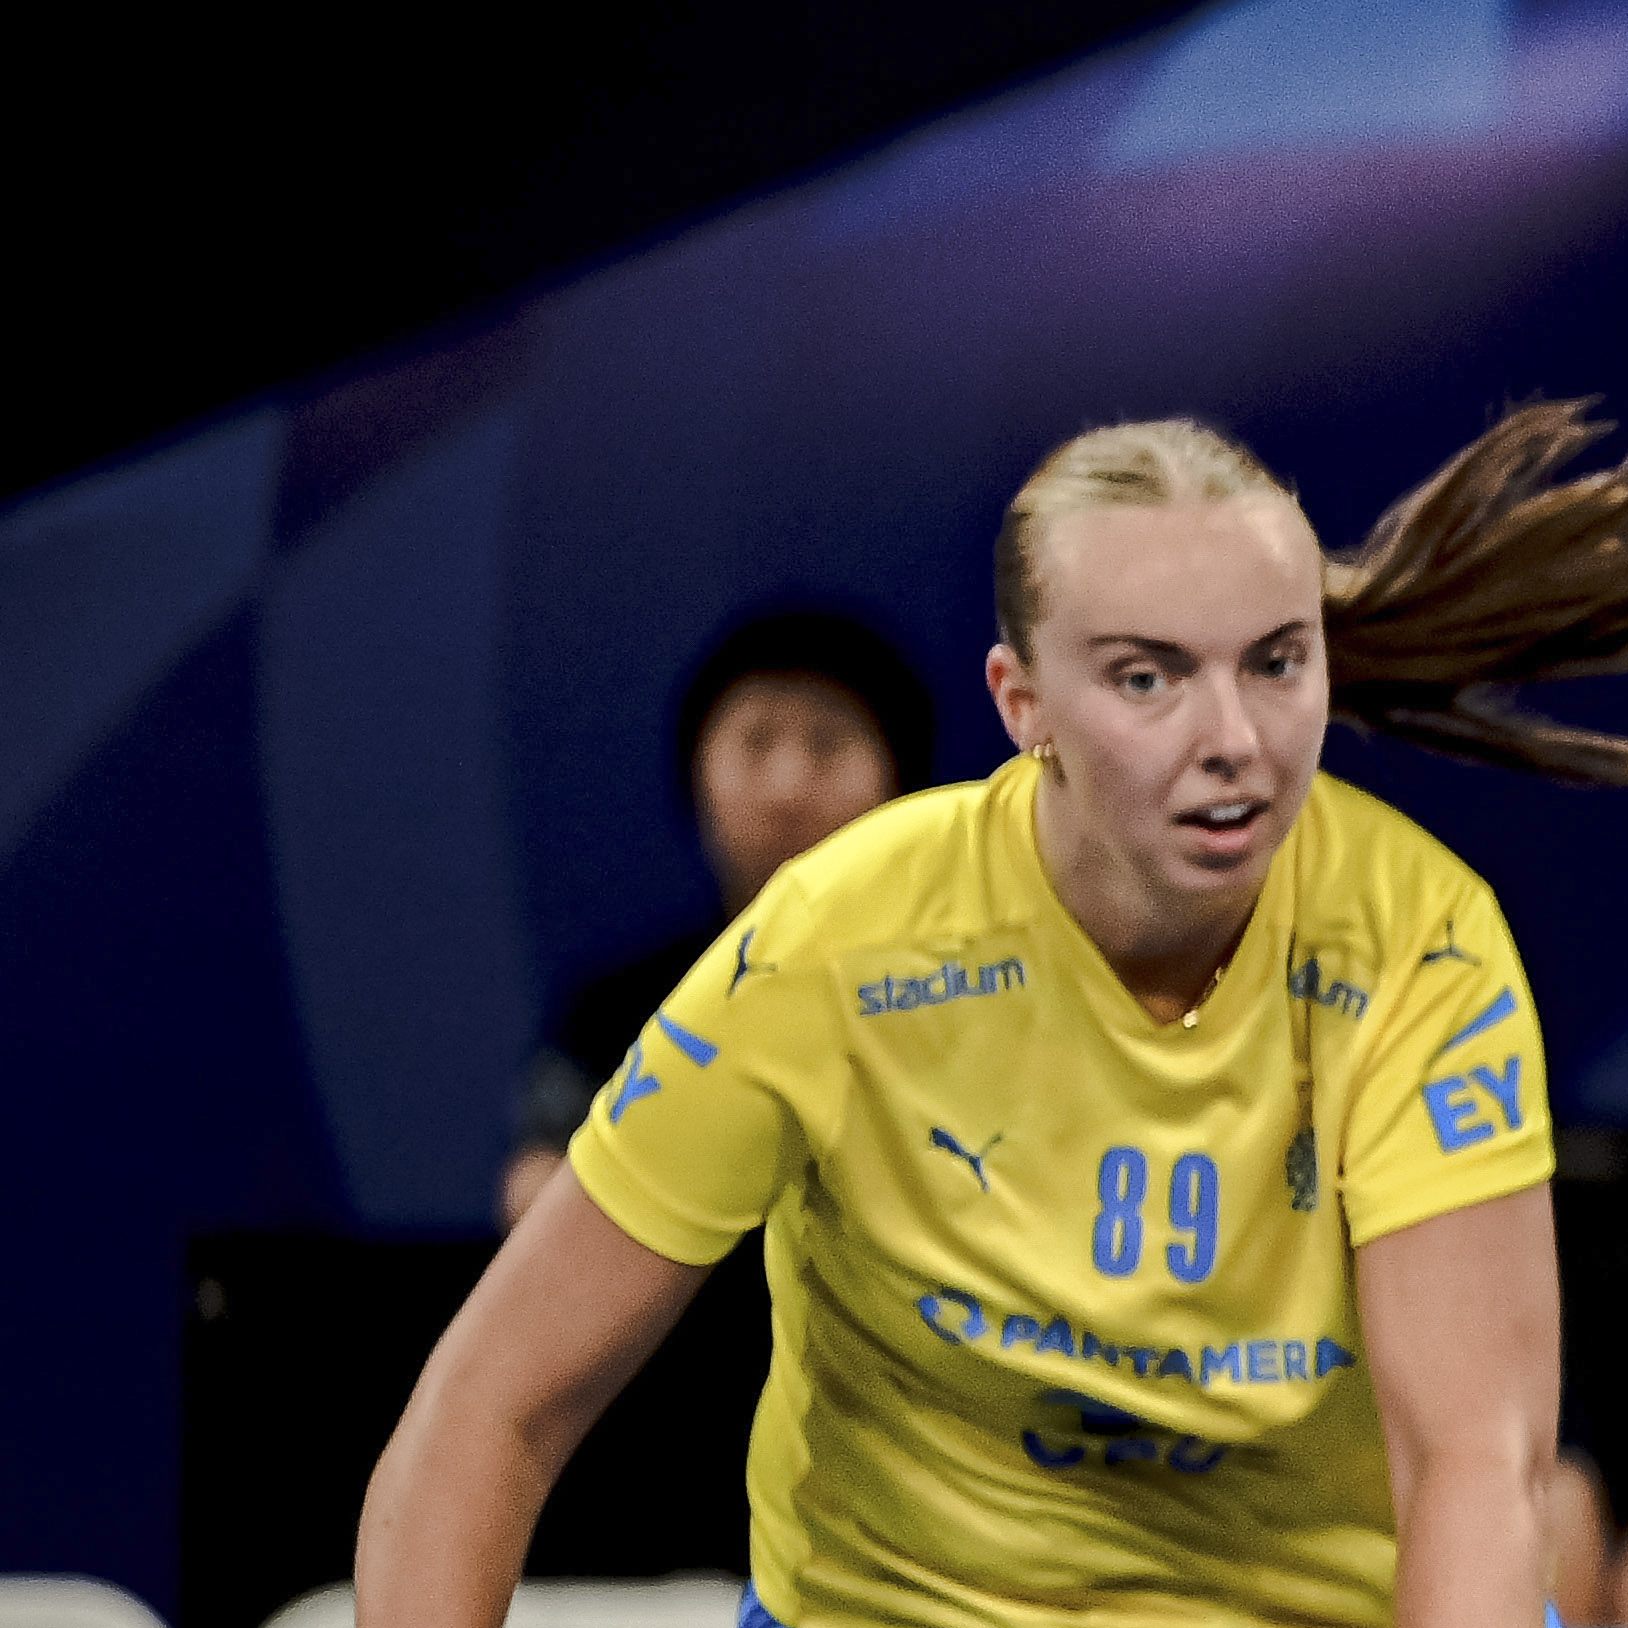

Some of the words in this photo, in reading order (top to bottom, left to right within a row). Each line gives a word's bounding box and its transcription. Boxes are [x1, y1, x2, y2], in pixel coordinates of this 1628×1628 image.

[858, 956, 1026, 1017] stadium
[1422, 1056, 1522, 1153] EY
[1093, 1146, 1221, 1283] 89
